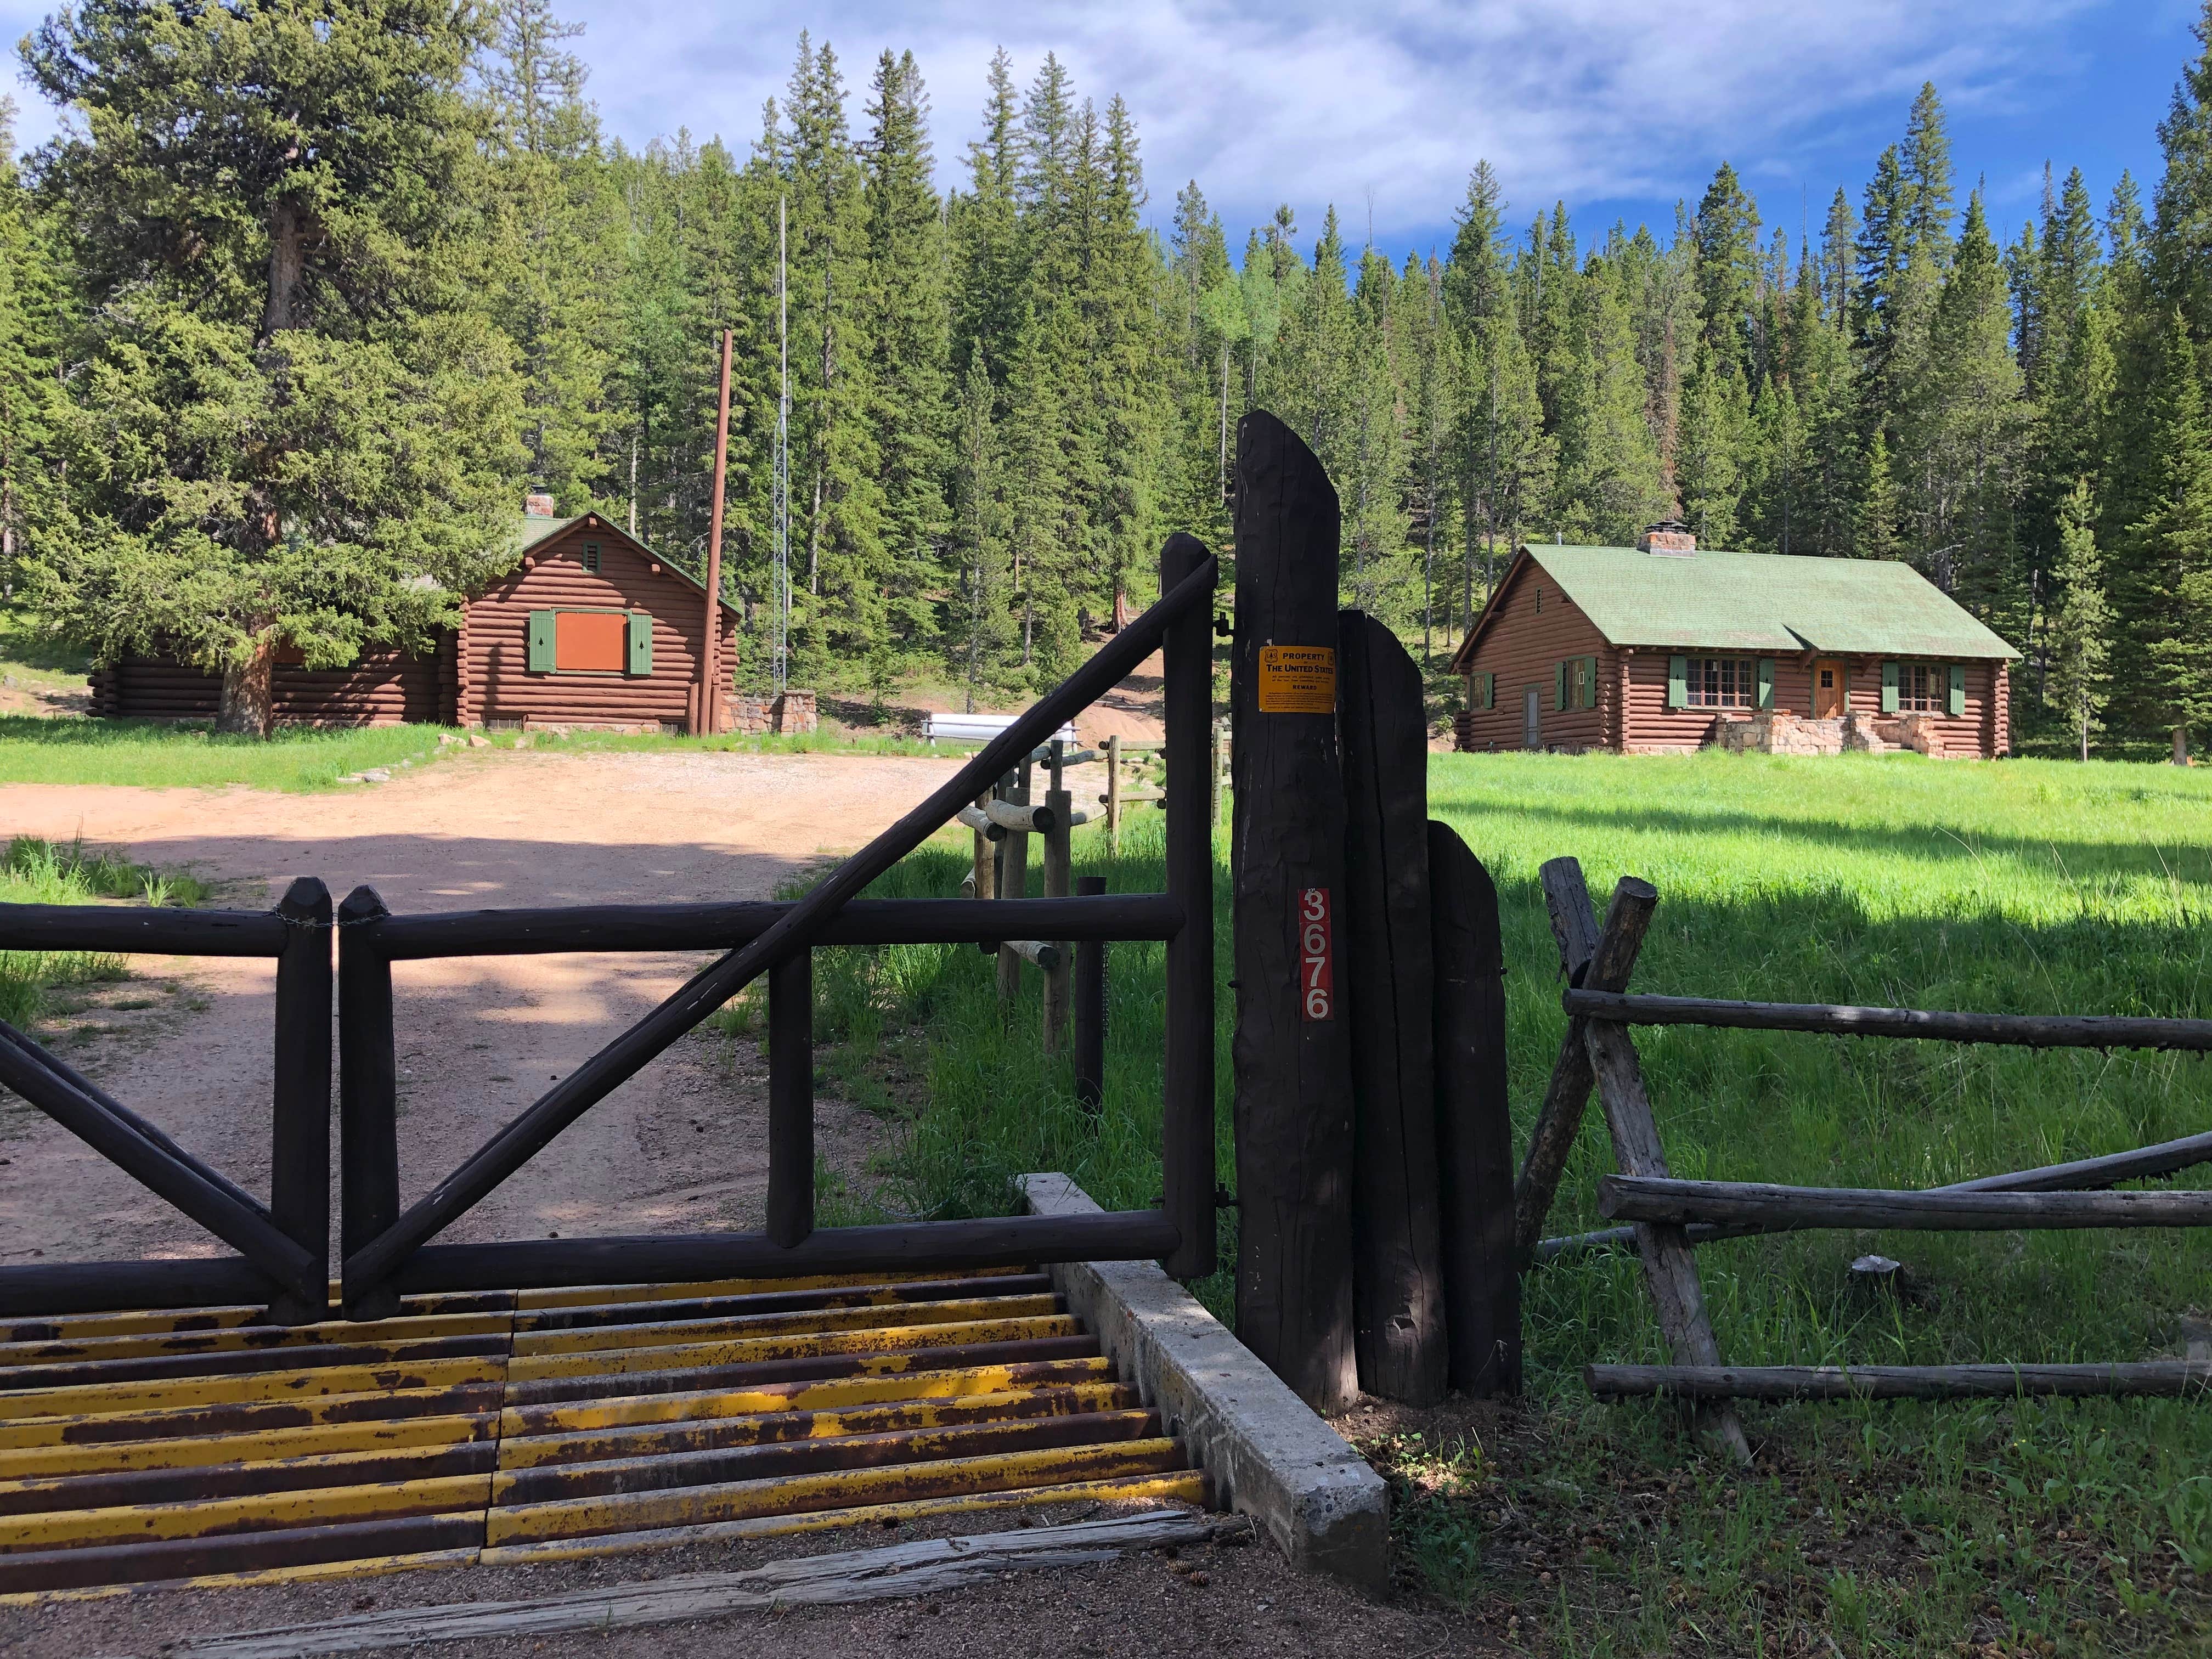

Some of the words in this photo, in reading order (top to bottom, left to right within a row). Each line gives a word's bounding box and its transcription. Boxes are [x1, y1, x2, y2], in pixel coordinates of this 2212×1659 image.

[1283, 652, 1325, 661] PROPERTY
[1266, 664, 1283, 672] THE
[1284, 664, 1313, 673] UNITED
[1314, 665, 1333, 674] STATES
[1304, 889, 1328, 1019] 3676
